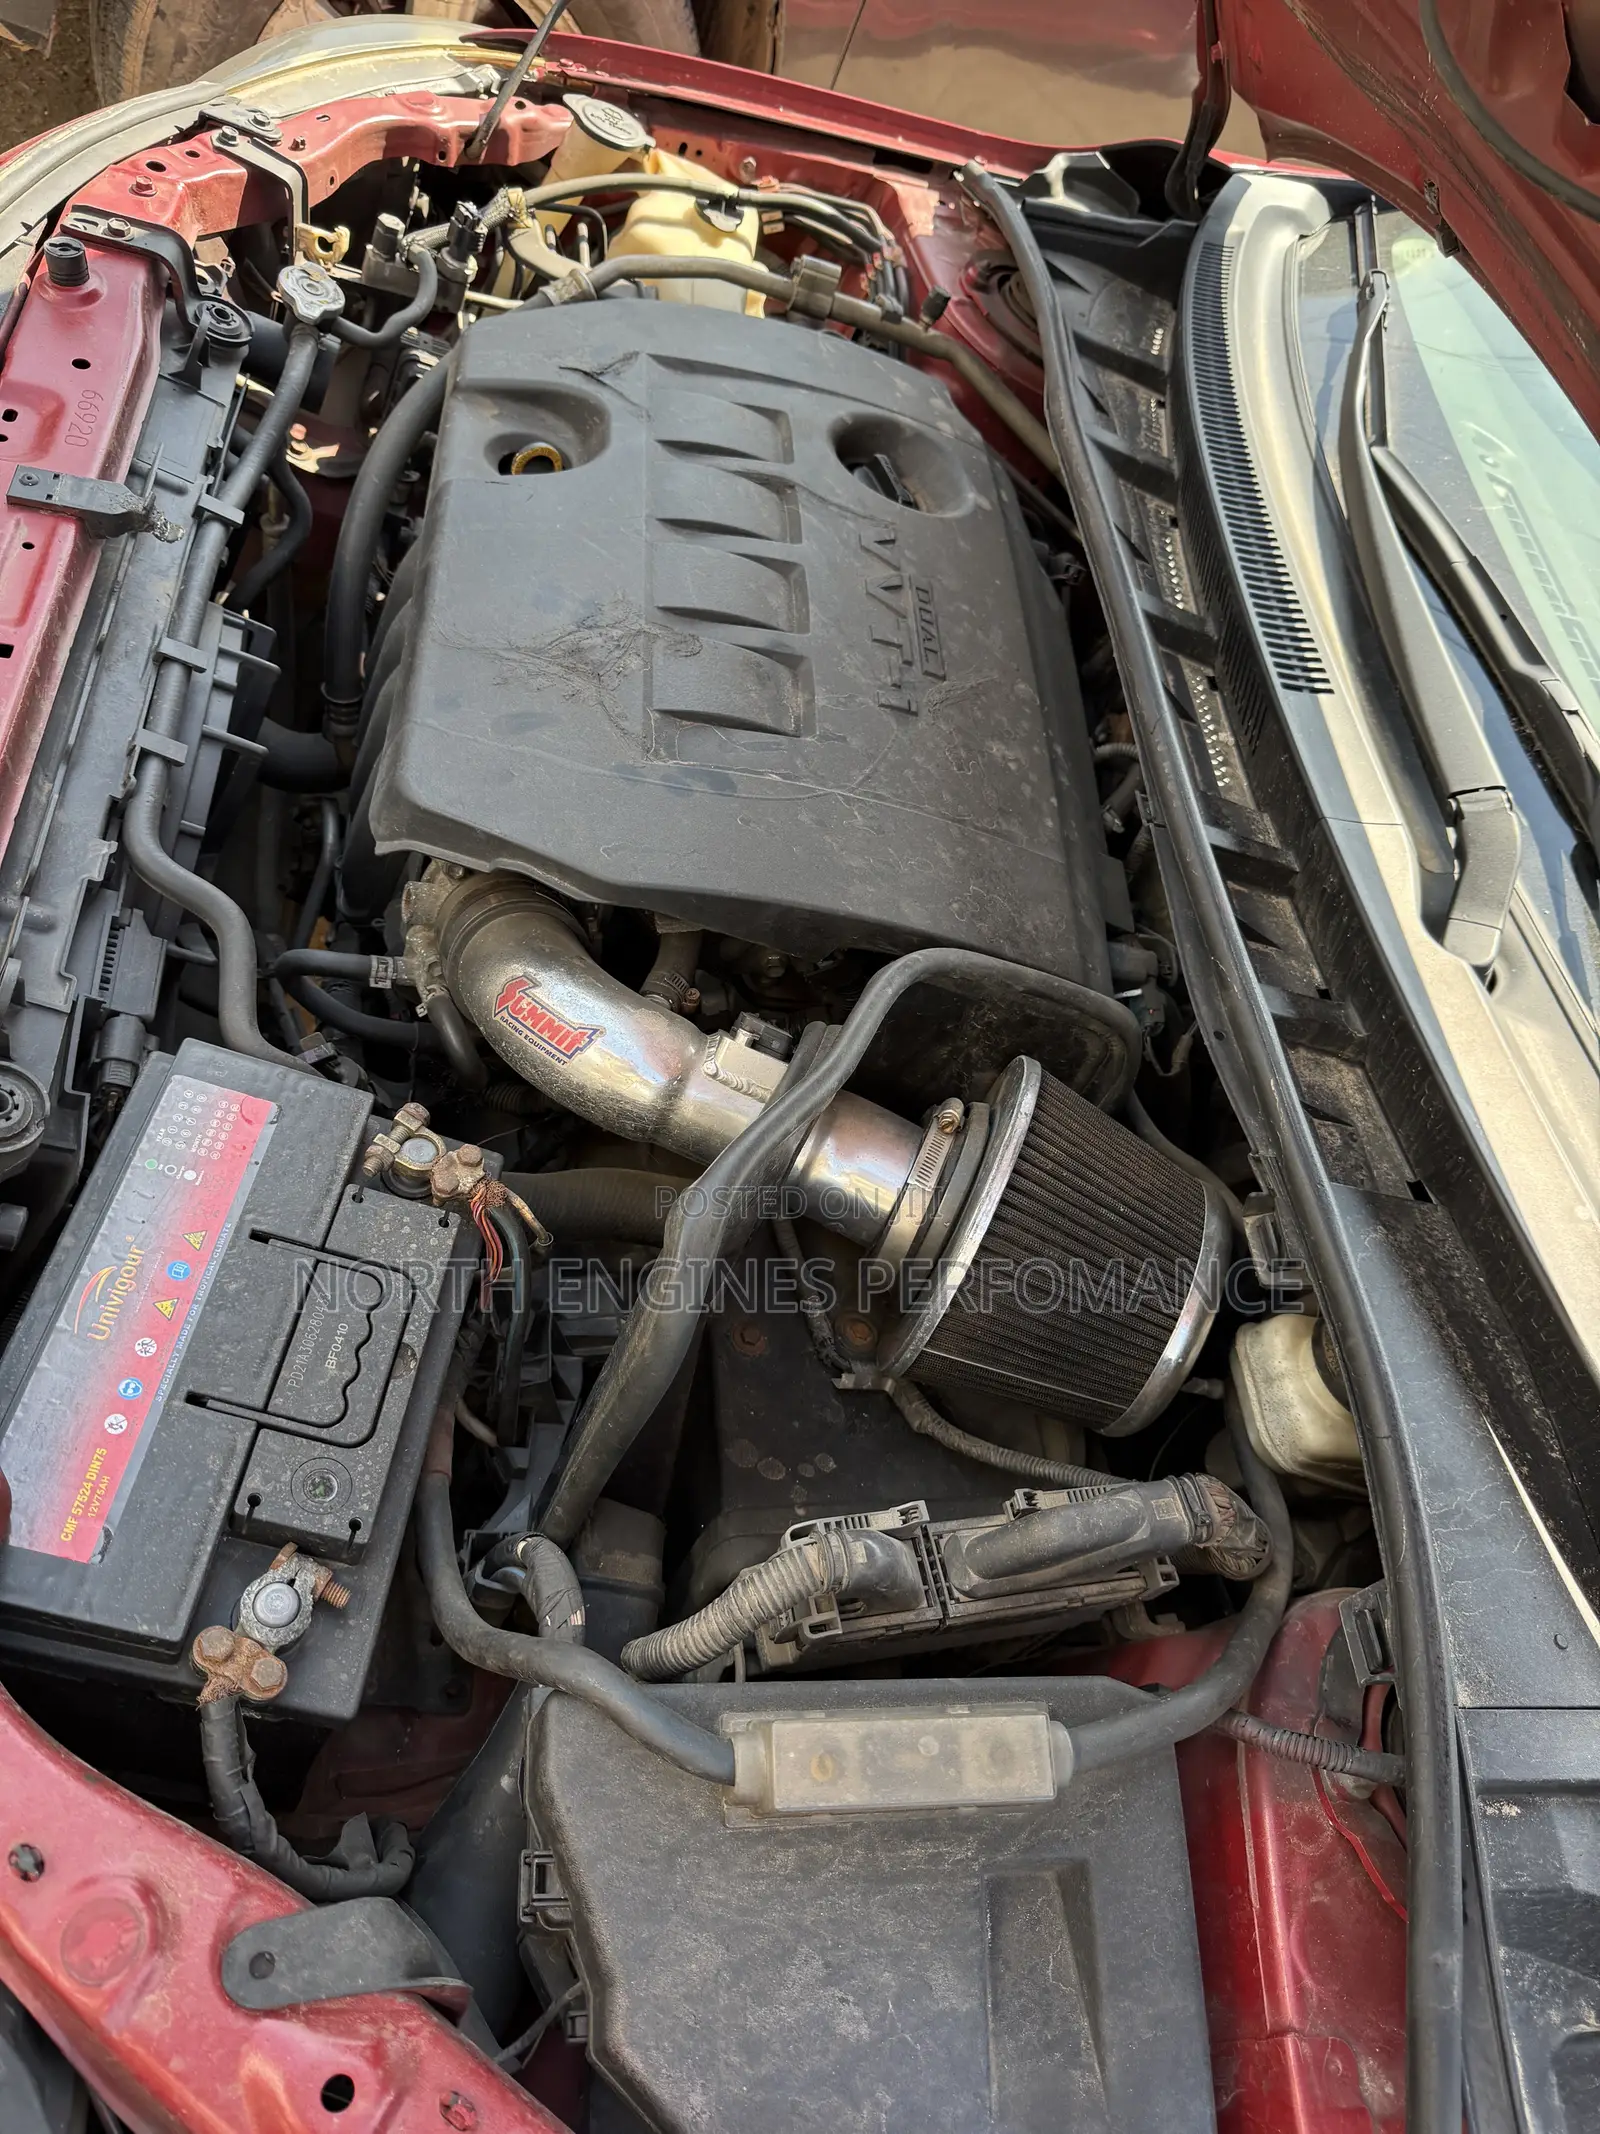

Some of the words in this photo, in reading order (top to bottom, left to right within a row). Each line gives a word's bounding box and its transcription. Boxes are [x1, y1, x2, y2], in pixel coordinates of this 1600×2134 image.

[65, 389, 104, 448] 66920
[915, 585, 940, 664] DUAL
[500, 1014, 523, 1036] RACING
[523, 1033, 568, 1066] EQUIPMENT
[87, 1244, 146, 1341] Univigour
[155, 1352, 180, 1402] SPECIALLY
[176, 1322, 191, 1351] MADE
[188, 1303, 200, 1322] FOR
[197, 1260, 217, 1301] TROPICAL
[213, 1221, 232, 1258] CLIMATE
[325, 1322, 349, 1369] BF0410
[60, 1515, 79, 1542] CMF
[71, 1481, 93, 1516] 57524
[85, 1447, 108, 1481] DIN75
[87, 1475, 111, 1518] 12V75AH
